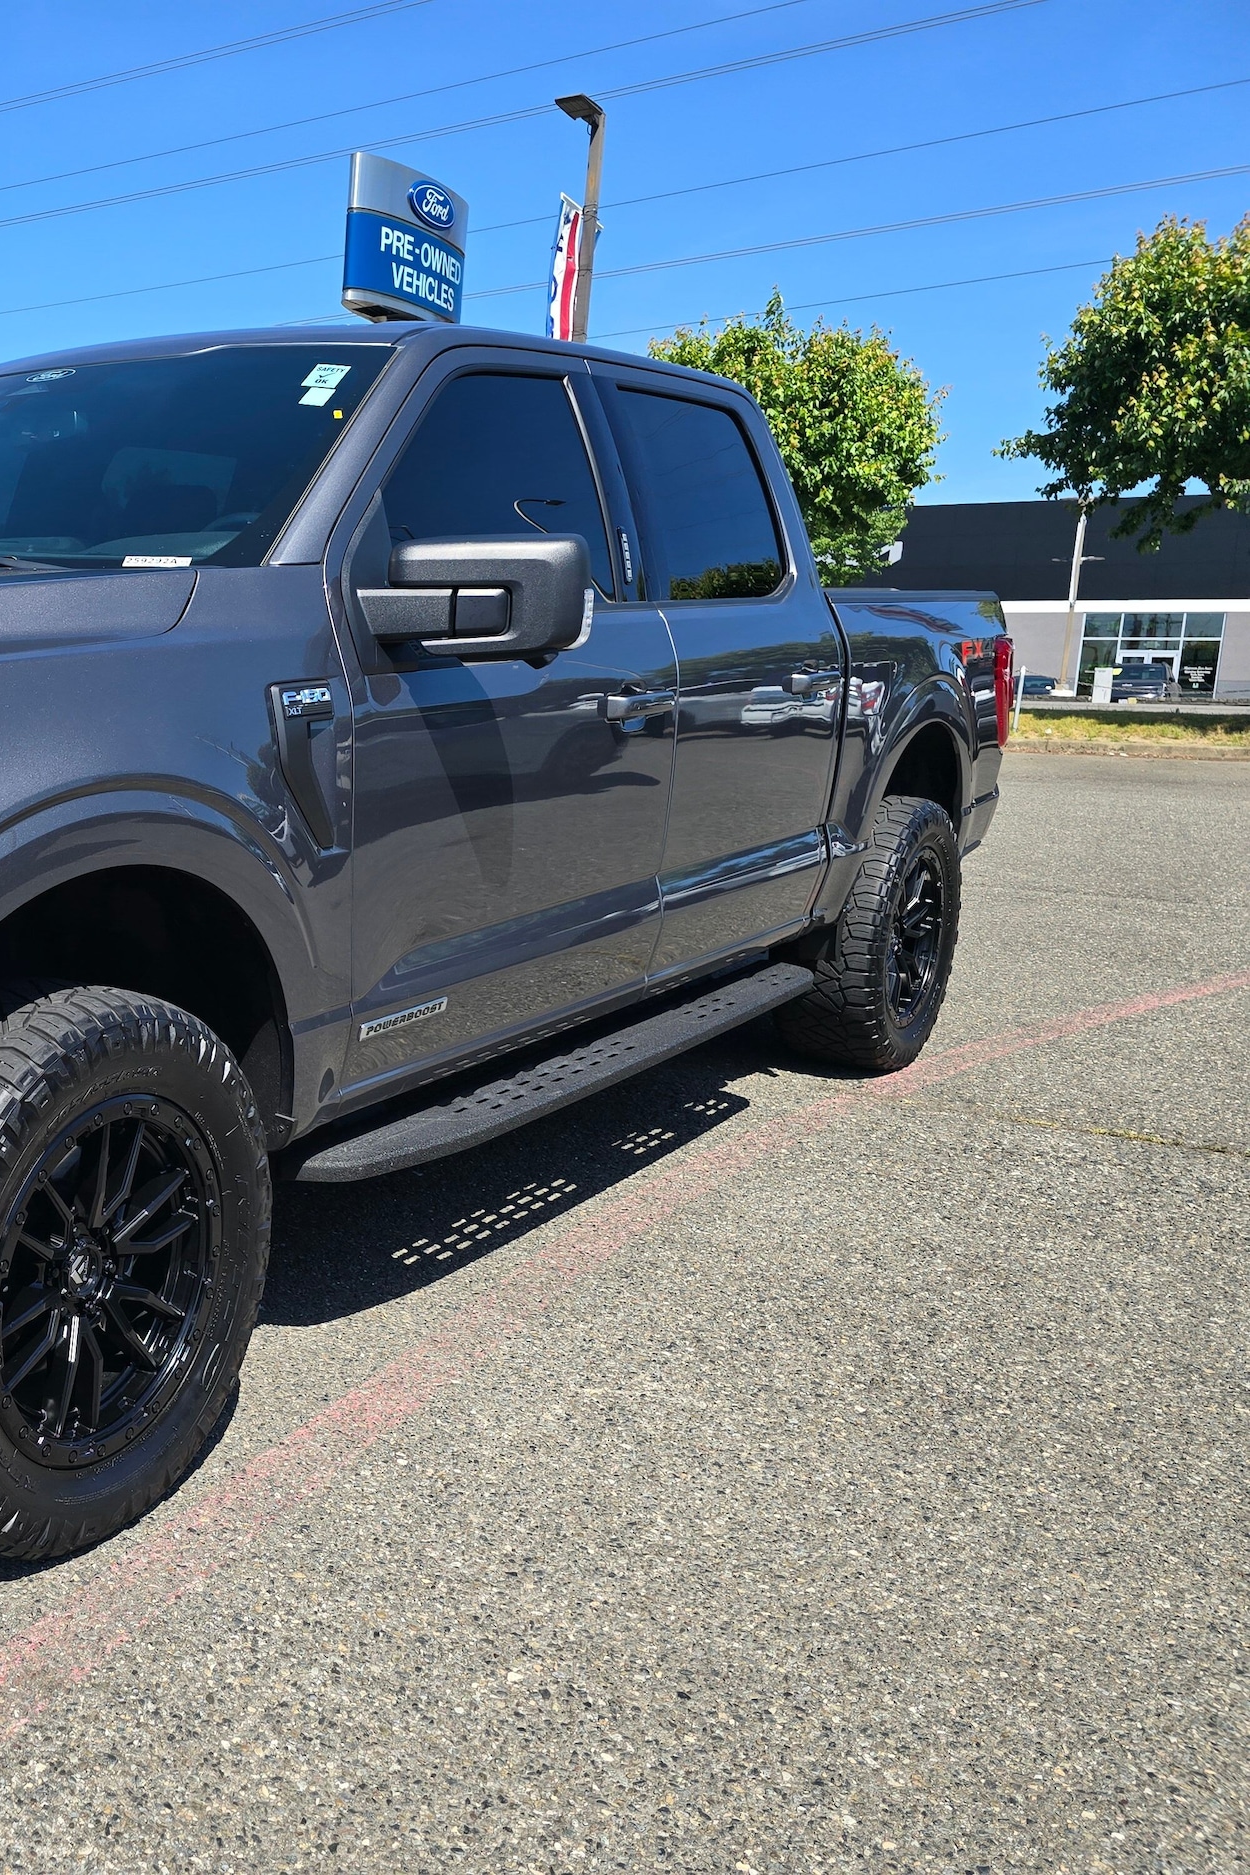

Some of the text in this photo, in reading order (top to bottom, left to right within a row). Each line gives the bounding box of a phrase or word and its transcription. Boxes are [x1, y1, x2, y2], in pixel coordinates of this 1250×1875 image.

[422, 187, 450, 221] Ford
[379, 225, 461, 285] PRE-OWNED
[391, 261, 455, 312] VEHICLES
[961, 638, 995, 667] FX4
[282, 687, 332, 706] F-150
[288, 707, 302, 716] XLT
[365, 1001, 445, 1036] POWERBOOST
